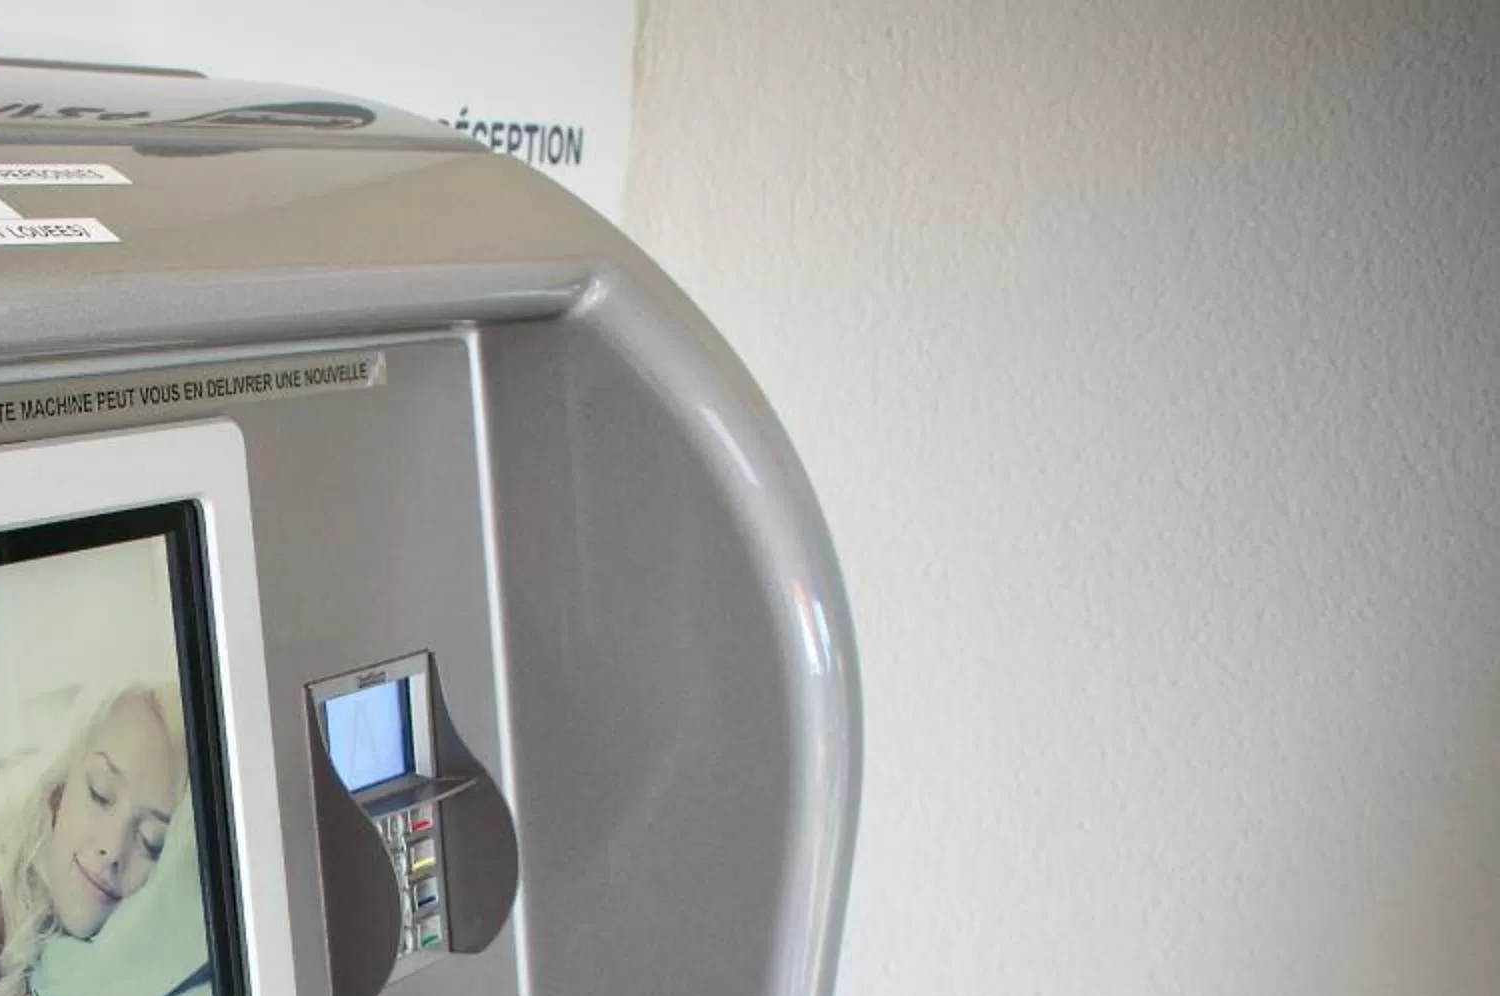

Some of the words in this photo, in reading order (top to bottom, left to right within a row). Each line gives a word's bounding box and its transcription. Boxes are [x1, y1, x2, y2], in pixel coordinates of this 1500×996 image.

[438, 105, 584, 165] EPTION
[20, 392, 94, 421] MACHINE
[97, 389, 136, 412] PEUT
[139, 384, 182, 406] VOUS
[183, 381, 204, 400] EN
[206, 373, 274, 399] DELIVRER
[276, 369, 302, 390] UNE
[304, 362, 369, 386] NOUVELLE
